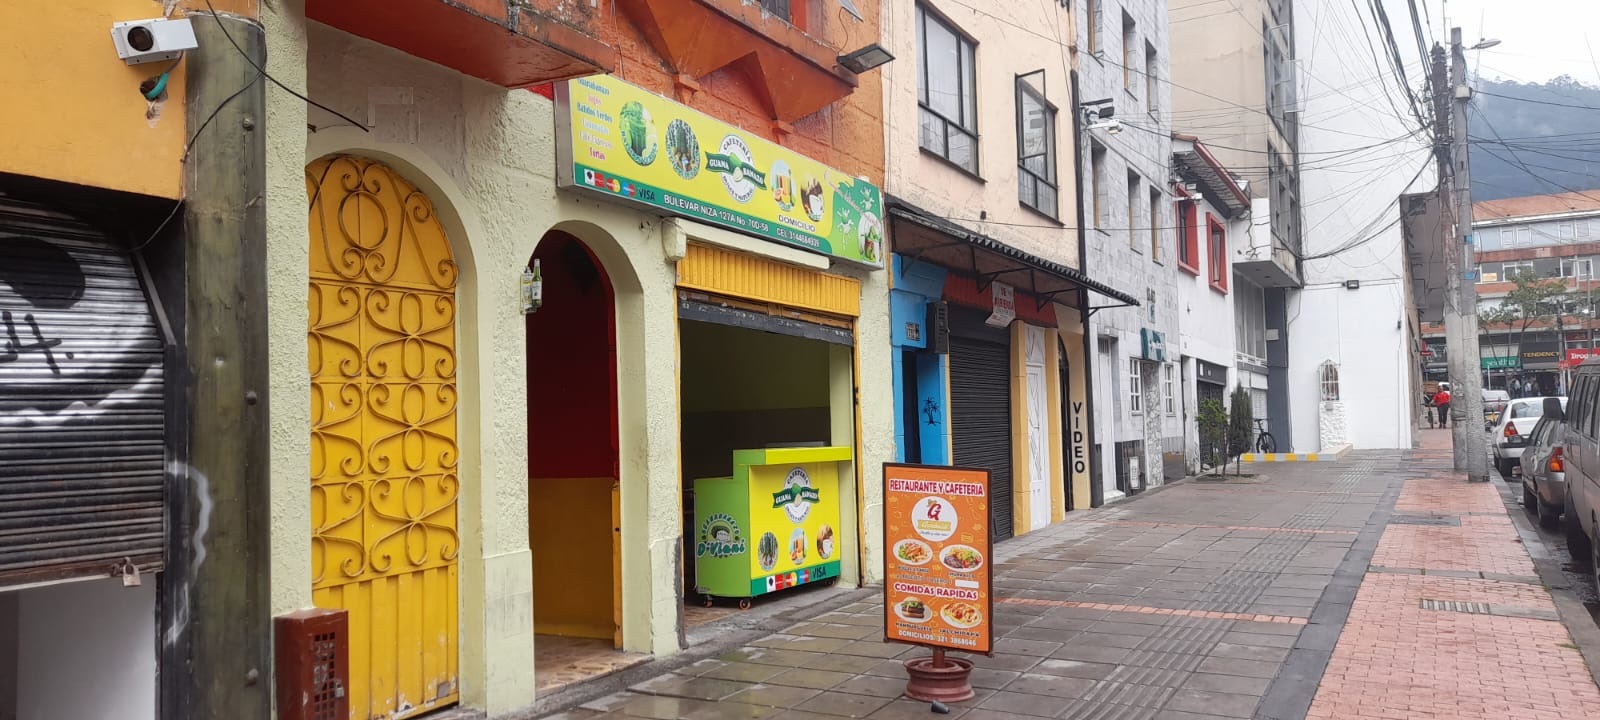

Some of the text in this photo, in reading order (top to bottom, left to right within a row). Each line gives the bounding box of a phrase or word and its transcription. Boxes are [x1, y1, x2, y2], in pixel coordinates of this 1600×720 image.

[709, 159, 730, 170] GUANA
[639, 190, 656, 201] VISA
[664, 194, 700, 212] BULEVAR
[700, 205, 719, 217] NIZA
[778, 214, 816, 232] DOMICILIO
[1073, 401, 1085, 474] VIDEO
[890, 480, 984, 496] RESTAURANTE Y CAFETERIA
[813, 566, 826, 578] VISA
[894, 583, 977, 599] COMIDAS RAPIDAS
